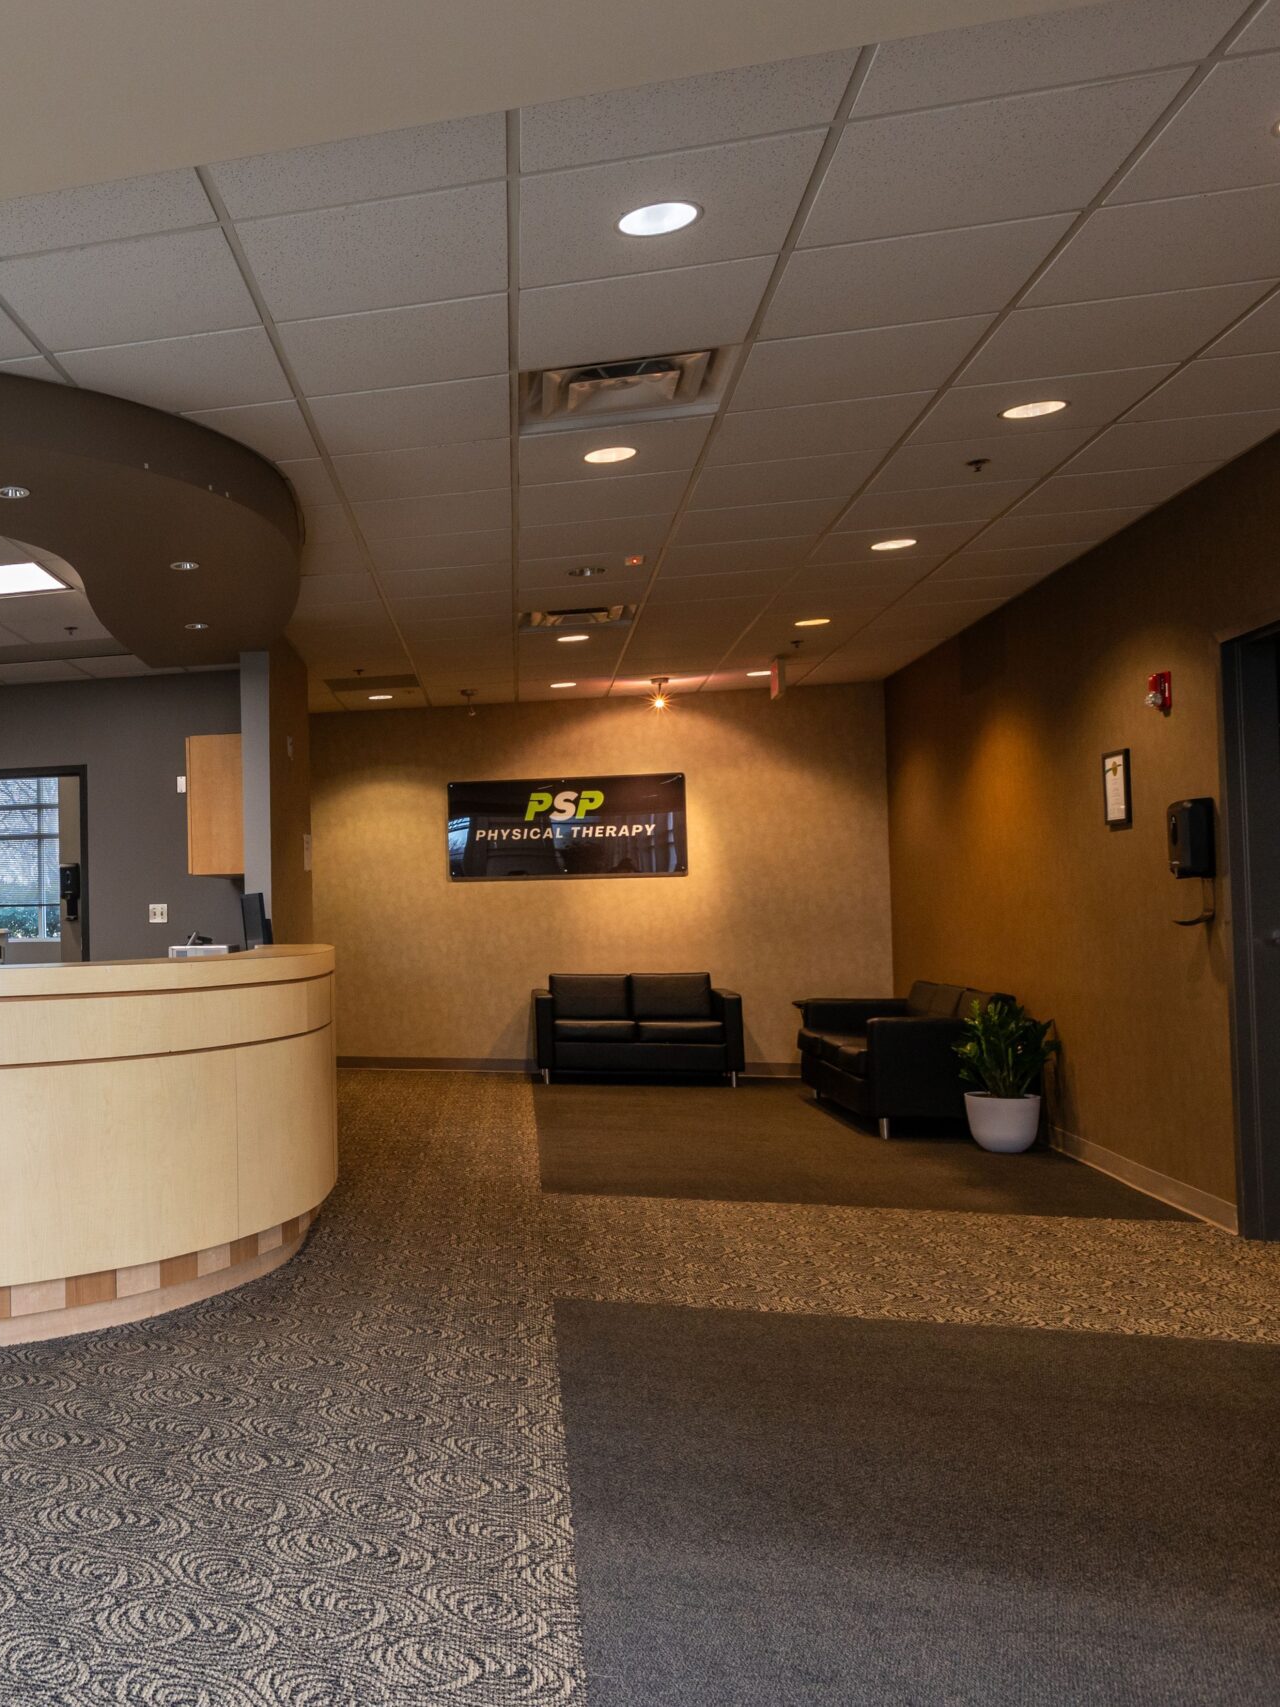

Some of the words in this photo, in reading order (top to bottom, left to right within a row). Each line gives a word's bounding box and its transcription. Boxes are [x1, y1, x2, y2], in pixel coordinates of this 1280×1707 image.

[524, 790, 604, 821] PSP
[475, 827, 563, 841] PHYSICAL
[571, 824, 656, 838] THERAPY
